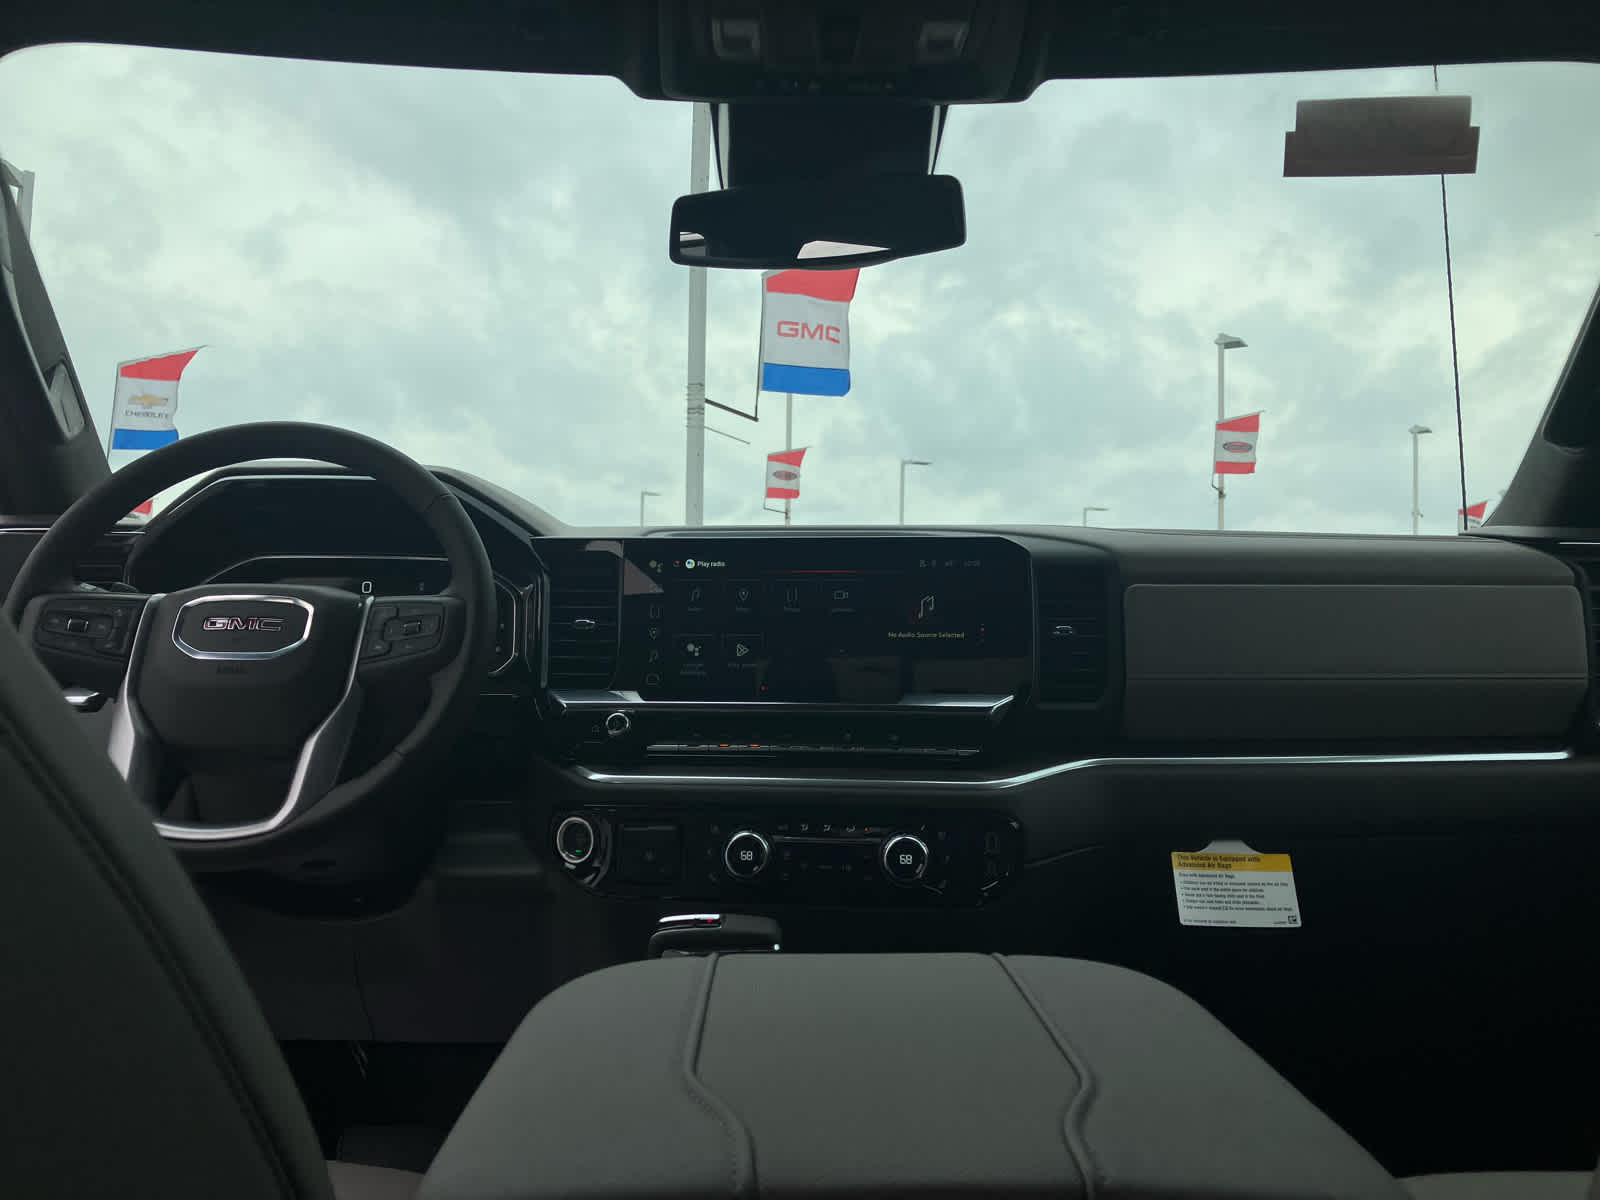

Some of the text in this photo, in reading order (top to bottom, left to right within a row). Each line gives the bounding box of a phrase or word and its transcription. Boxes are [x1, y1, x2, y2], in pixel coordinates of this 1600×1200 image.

[777, 320, 840, 344] GMC
[697, 560, 726, 569] Play radio
[361, 581, 373, 594] 0
[203, 616, 286, 632] GMC
[939, 631, 965, 639] Selected
[740, 850, 752, 861] 68
[900, 854, 912, 865] 68
[1219, 855, 1246, 863] Equipped
[1217, 862, 1232, 870] Bags
